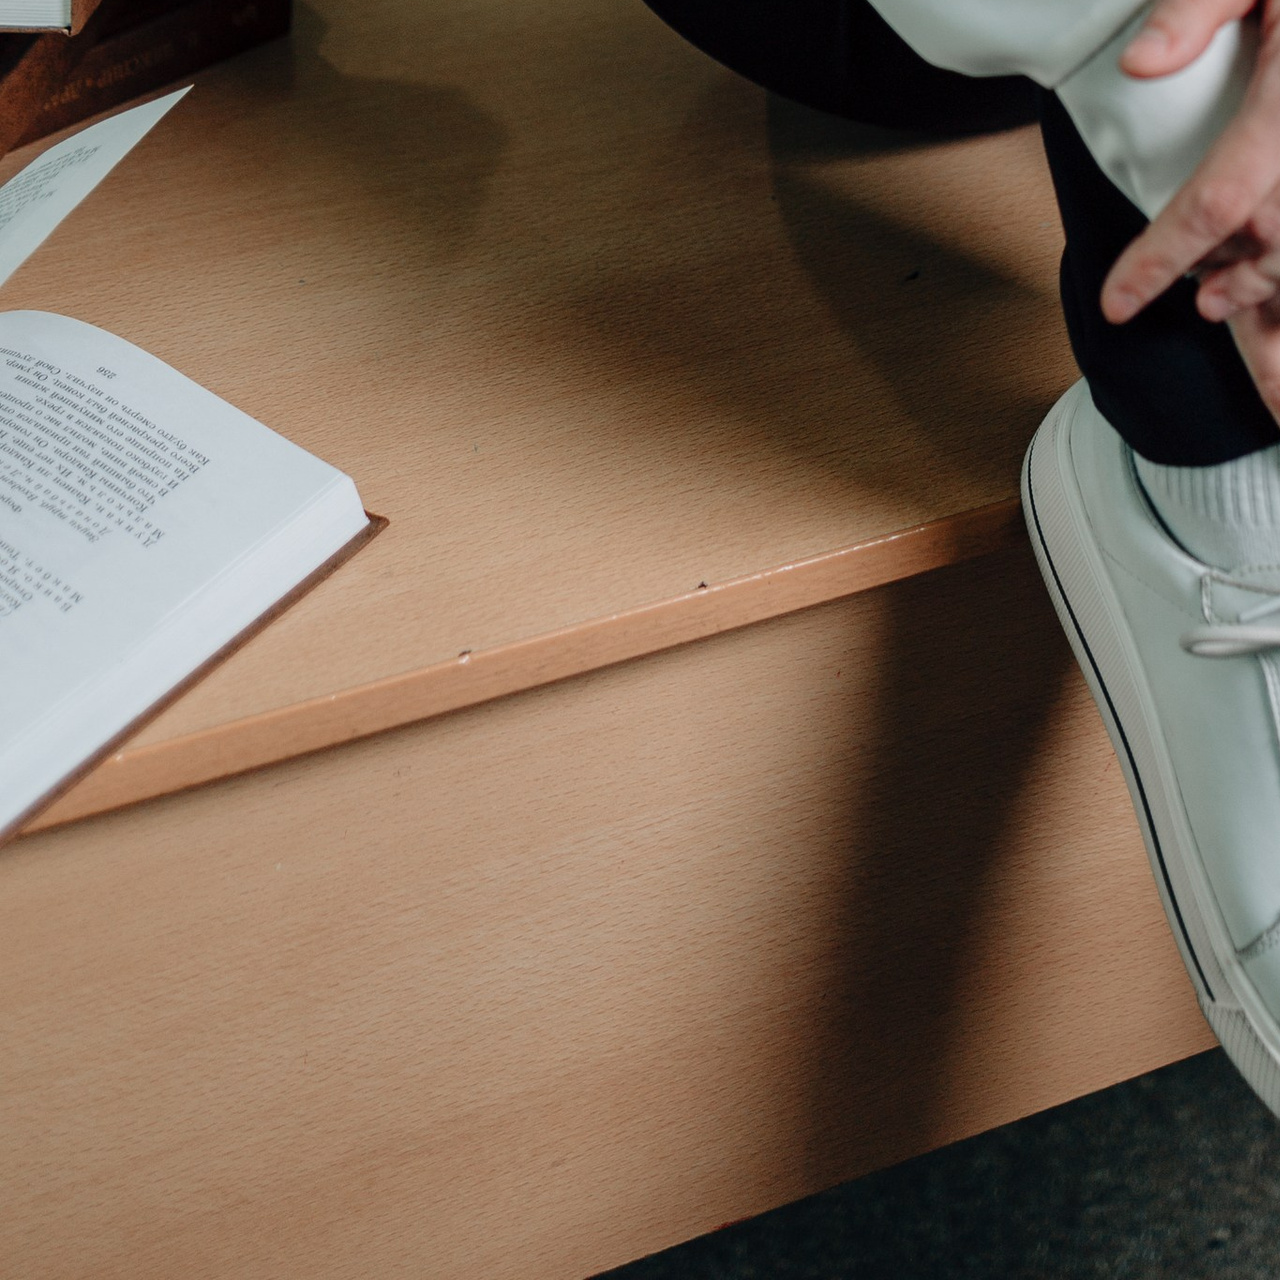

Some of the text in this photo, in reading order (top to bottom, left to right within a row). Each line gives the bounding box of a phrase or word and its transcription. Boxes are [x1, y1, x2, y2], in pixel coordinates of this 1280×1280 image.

[33, 359, 62, 376] Свой
[95, 366, 117, 380] 256
[32, 370, 49, 382] Он
[85, 397, 109, 415] был
[104, 395, 120, 407] он
[65, 413, 75, 421] в
[121, 404, 157, 430] смерть
[105, 423, 125, 438] его
[106, 411, 169, 453] прекрасней
[156, 428, 188, 451] будто
[169, 451, 201, 475] Всего
[187, 448, 211, 467] Как
[173, 467, 190, 482] На
[166, 479, 180, 490] И
[157, 487, 169, 498] В
